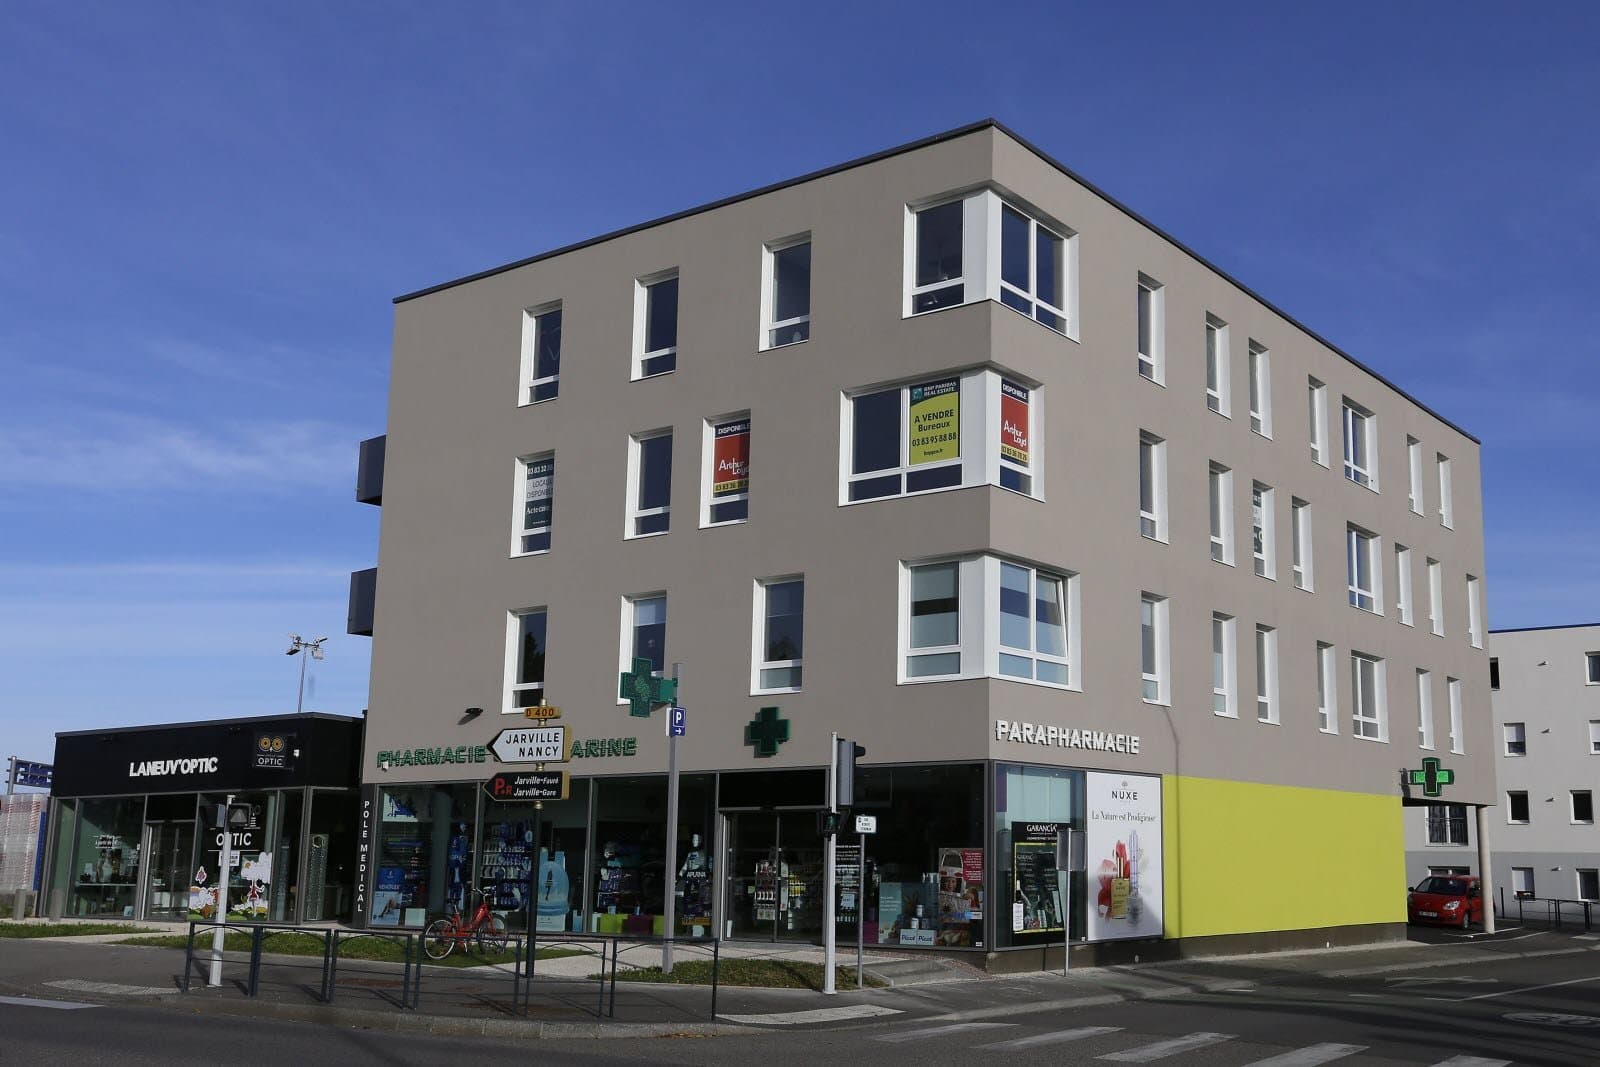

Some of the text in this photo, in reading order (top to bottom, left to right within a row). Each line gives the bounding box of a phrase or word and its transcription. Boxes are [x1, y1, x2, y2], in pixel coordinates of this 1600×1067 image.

[1002, 383, 1027, 400] DISPONIBLE
[914, 409, 954, 424] A VENDRE
[918, 421, 950, 432] Bureaux
[526, 708, 554, 717] D 400
[676, 711, 682, 724] P
[506, 732, 560, 744] JARVILLE
[996, 719, 1140, 754] PARAPHARMACIE
[377, 736, 638, 768] PHARMACIE ARINE
[518, 746, 559, 758] NANCY
[258, 757, 283, 766] OPTIC
[1111, 790, 1138, 801] NUXE
[216, 832, 252, 846] OTIC
[357, 800, 370, 912] POLE MEDICAL
